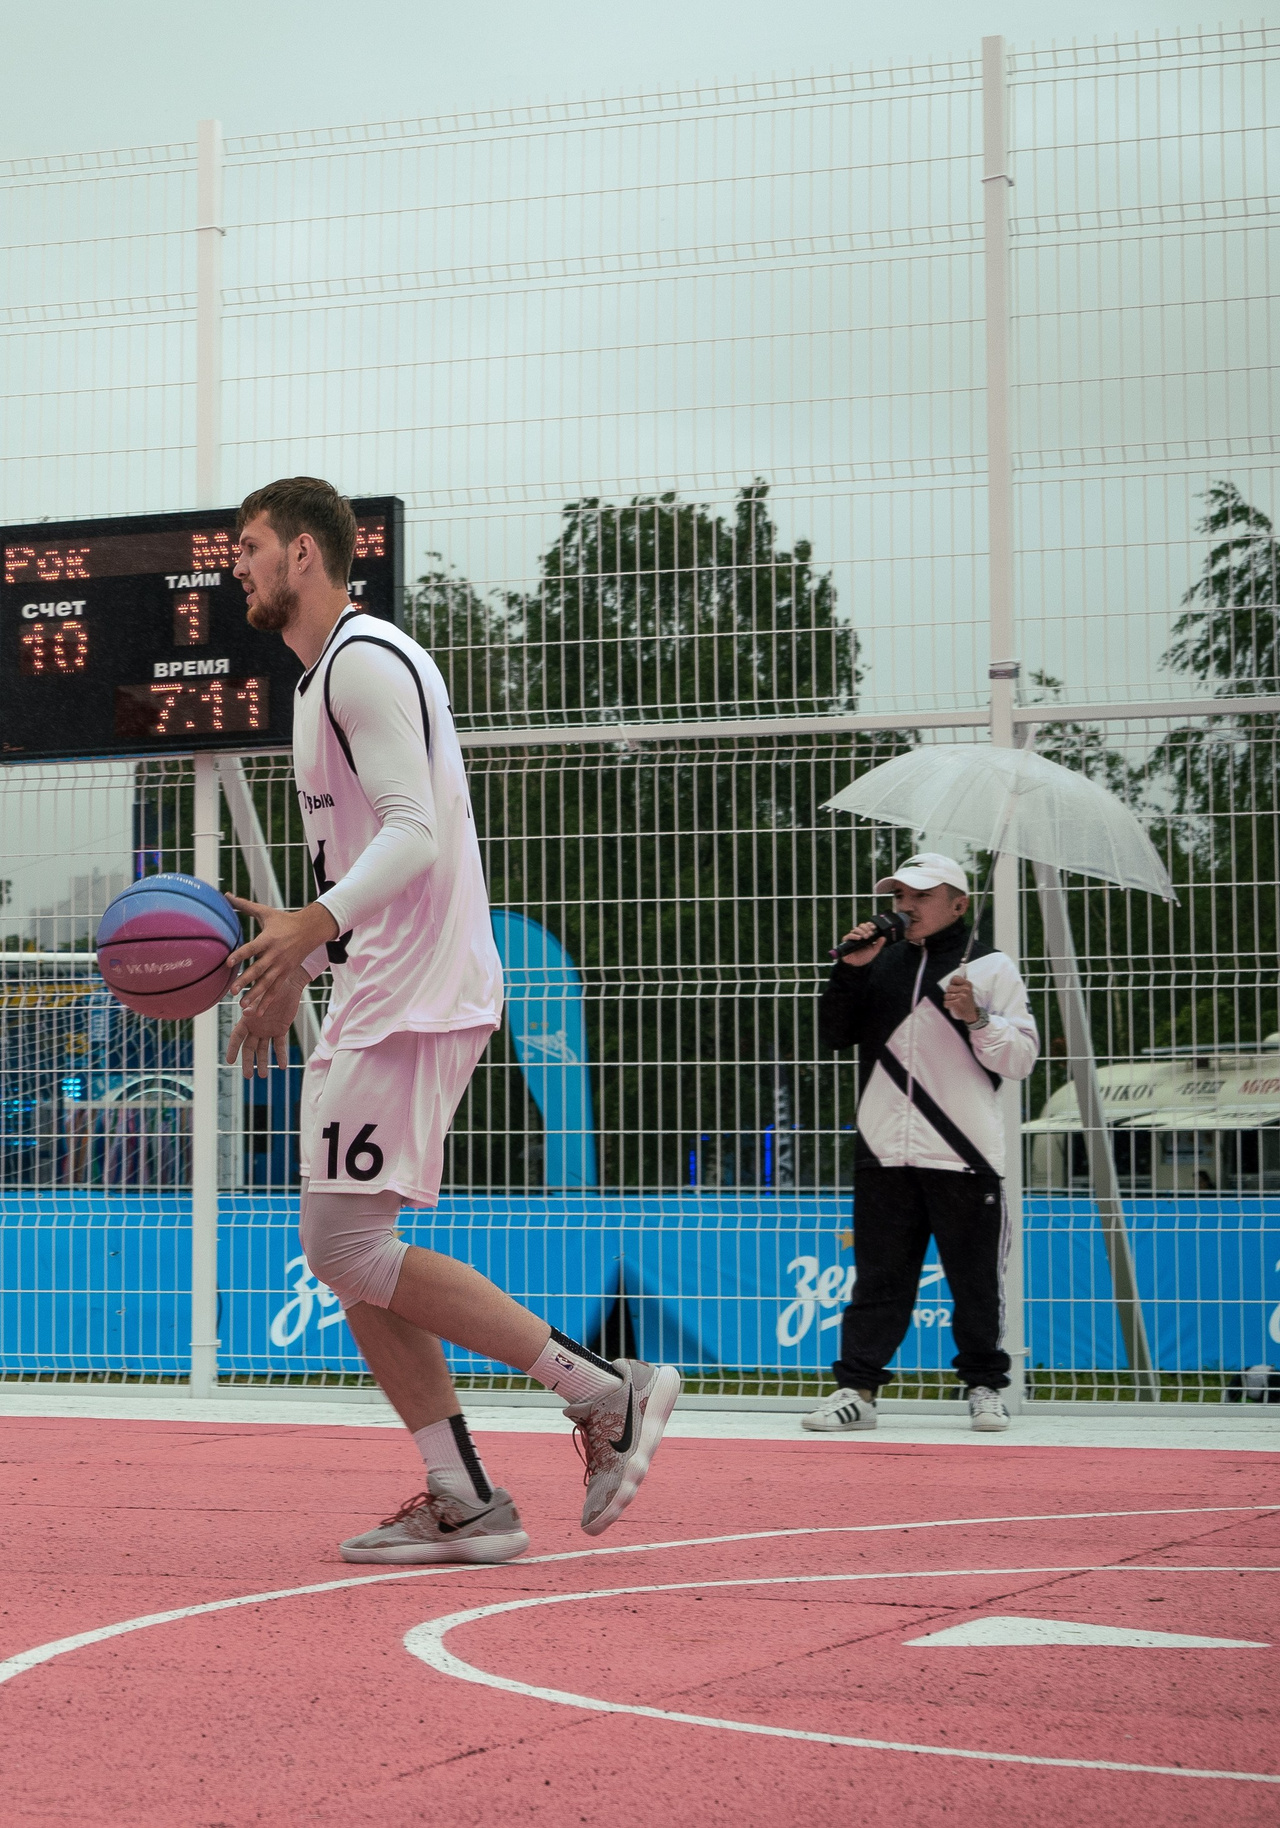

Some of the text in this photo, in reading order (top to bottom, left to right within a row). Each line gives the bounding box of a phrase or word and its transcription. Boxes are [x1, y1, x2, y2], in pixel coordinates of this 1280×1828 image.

[5, 547, 90, 583] Рок
[164, 571, 221, 589] ТАЙМ
[21, 600, 87, 619] счет
[178, 592, 199, 645] 1
[22, 621, 88, 675] 10
[153, 658, 230, 678] ВРЕМЯ
[150, 678, 259, 732] 7:11
[126, 958, 194, 975] VK Музыка
[322, 1122, 384, 1182] 16
[912, 1308, 952, 1328] 192
